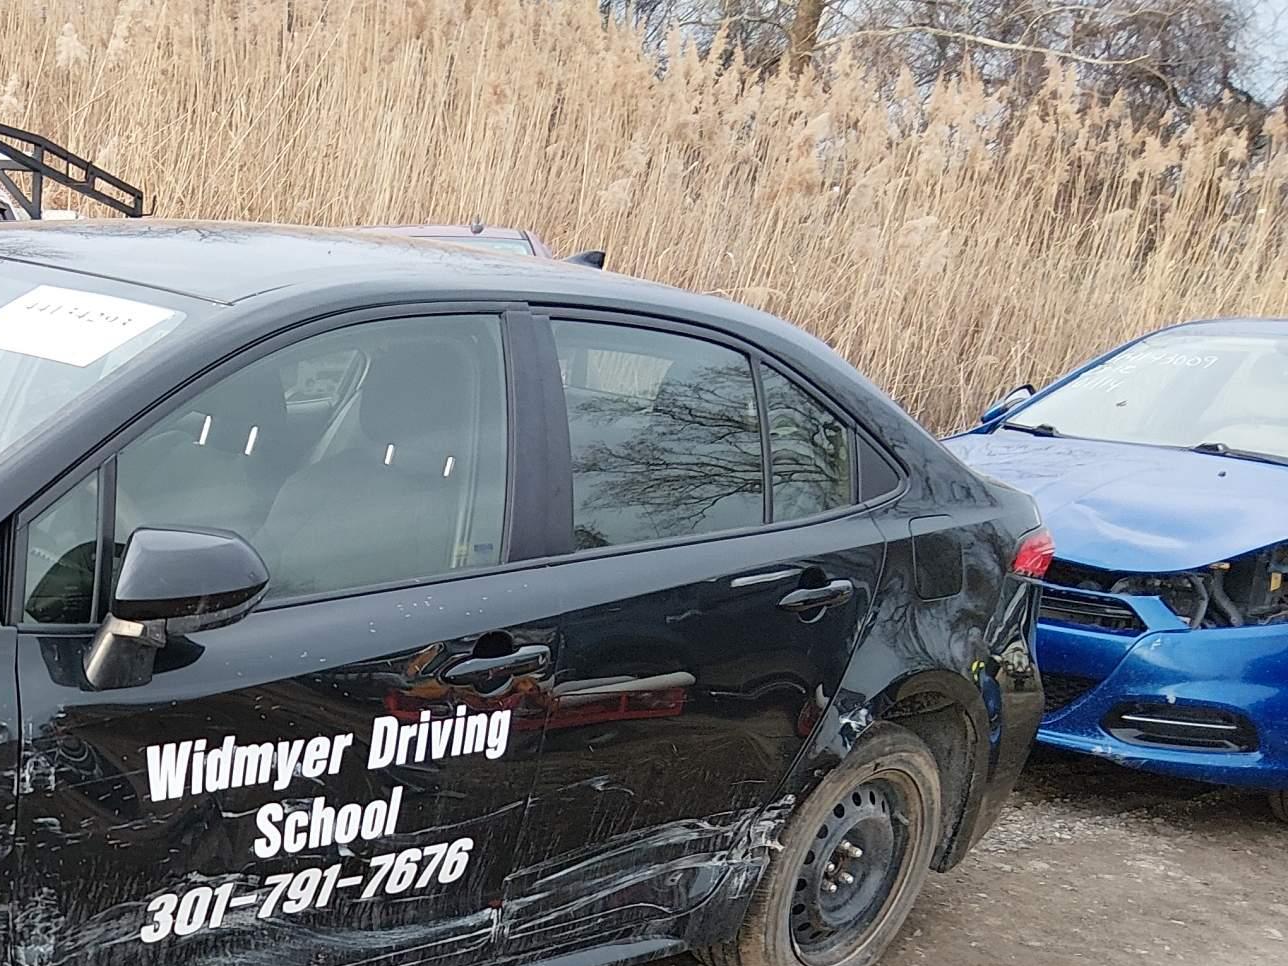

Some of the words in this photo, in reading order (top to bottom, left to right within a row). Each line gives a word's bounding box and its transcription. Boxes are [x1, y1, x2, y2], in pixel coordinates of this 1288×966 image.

[146, 732, 354, 802] Widmyer
[367, 704, 512, 770] Driving
[254, 786, 404, 859] School
[140, 837, 475, 944] 301-791-7676
